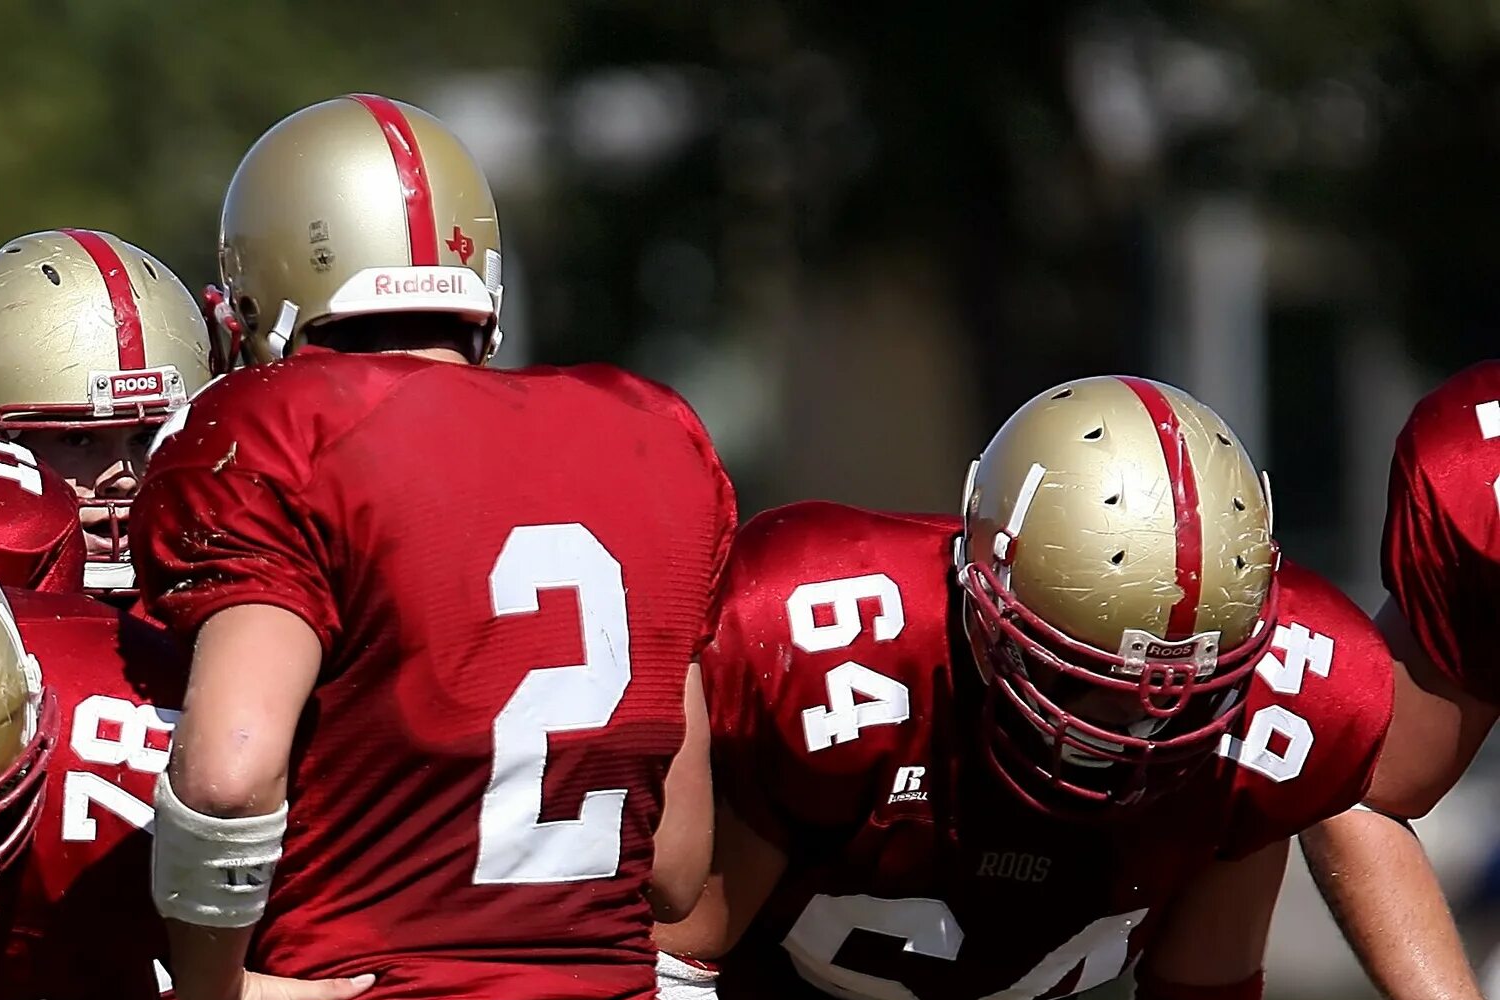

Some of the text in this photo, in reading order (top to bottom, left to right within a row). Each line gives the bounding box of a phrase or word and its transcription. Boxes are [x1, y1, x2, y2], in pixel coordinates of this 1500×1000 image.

[461, 239, 468, 254] 2
[375, 274, 463, 295] Riddell
[115, 376, 158, 394] ROOS
[786, 572, 910, 752] 64
[1149, 644, 1192, 657] ROOS
[473, 522, 632, 884] 2
[61, 694, 184, 842] 78
[975, 850, 1053, 883] ROOS
